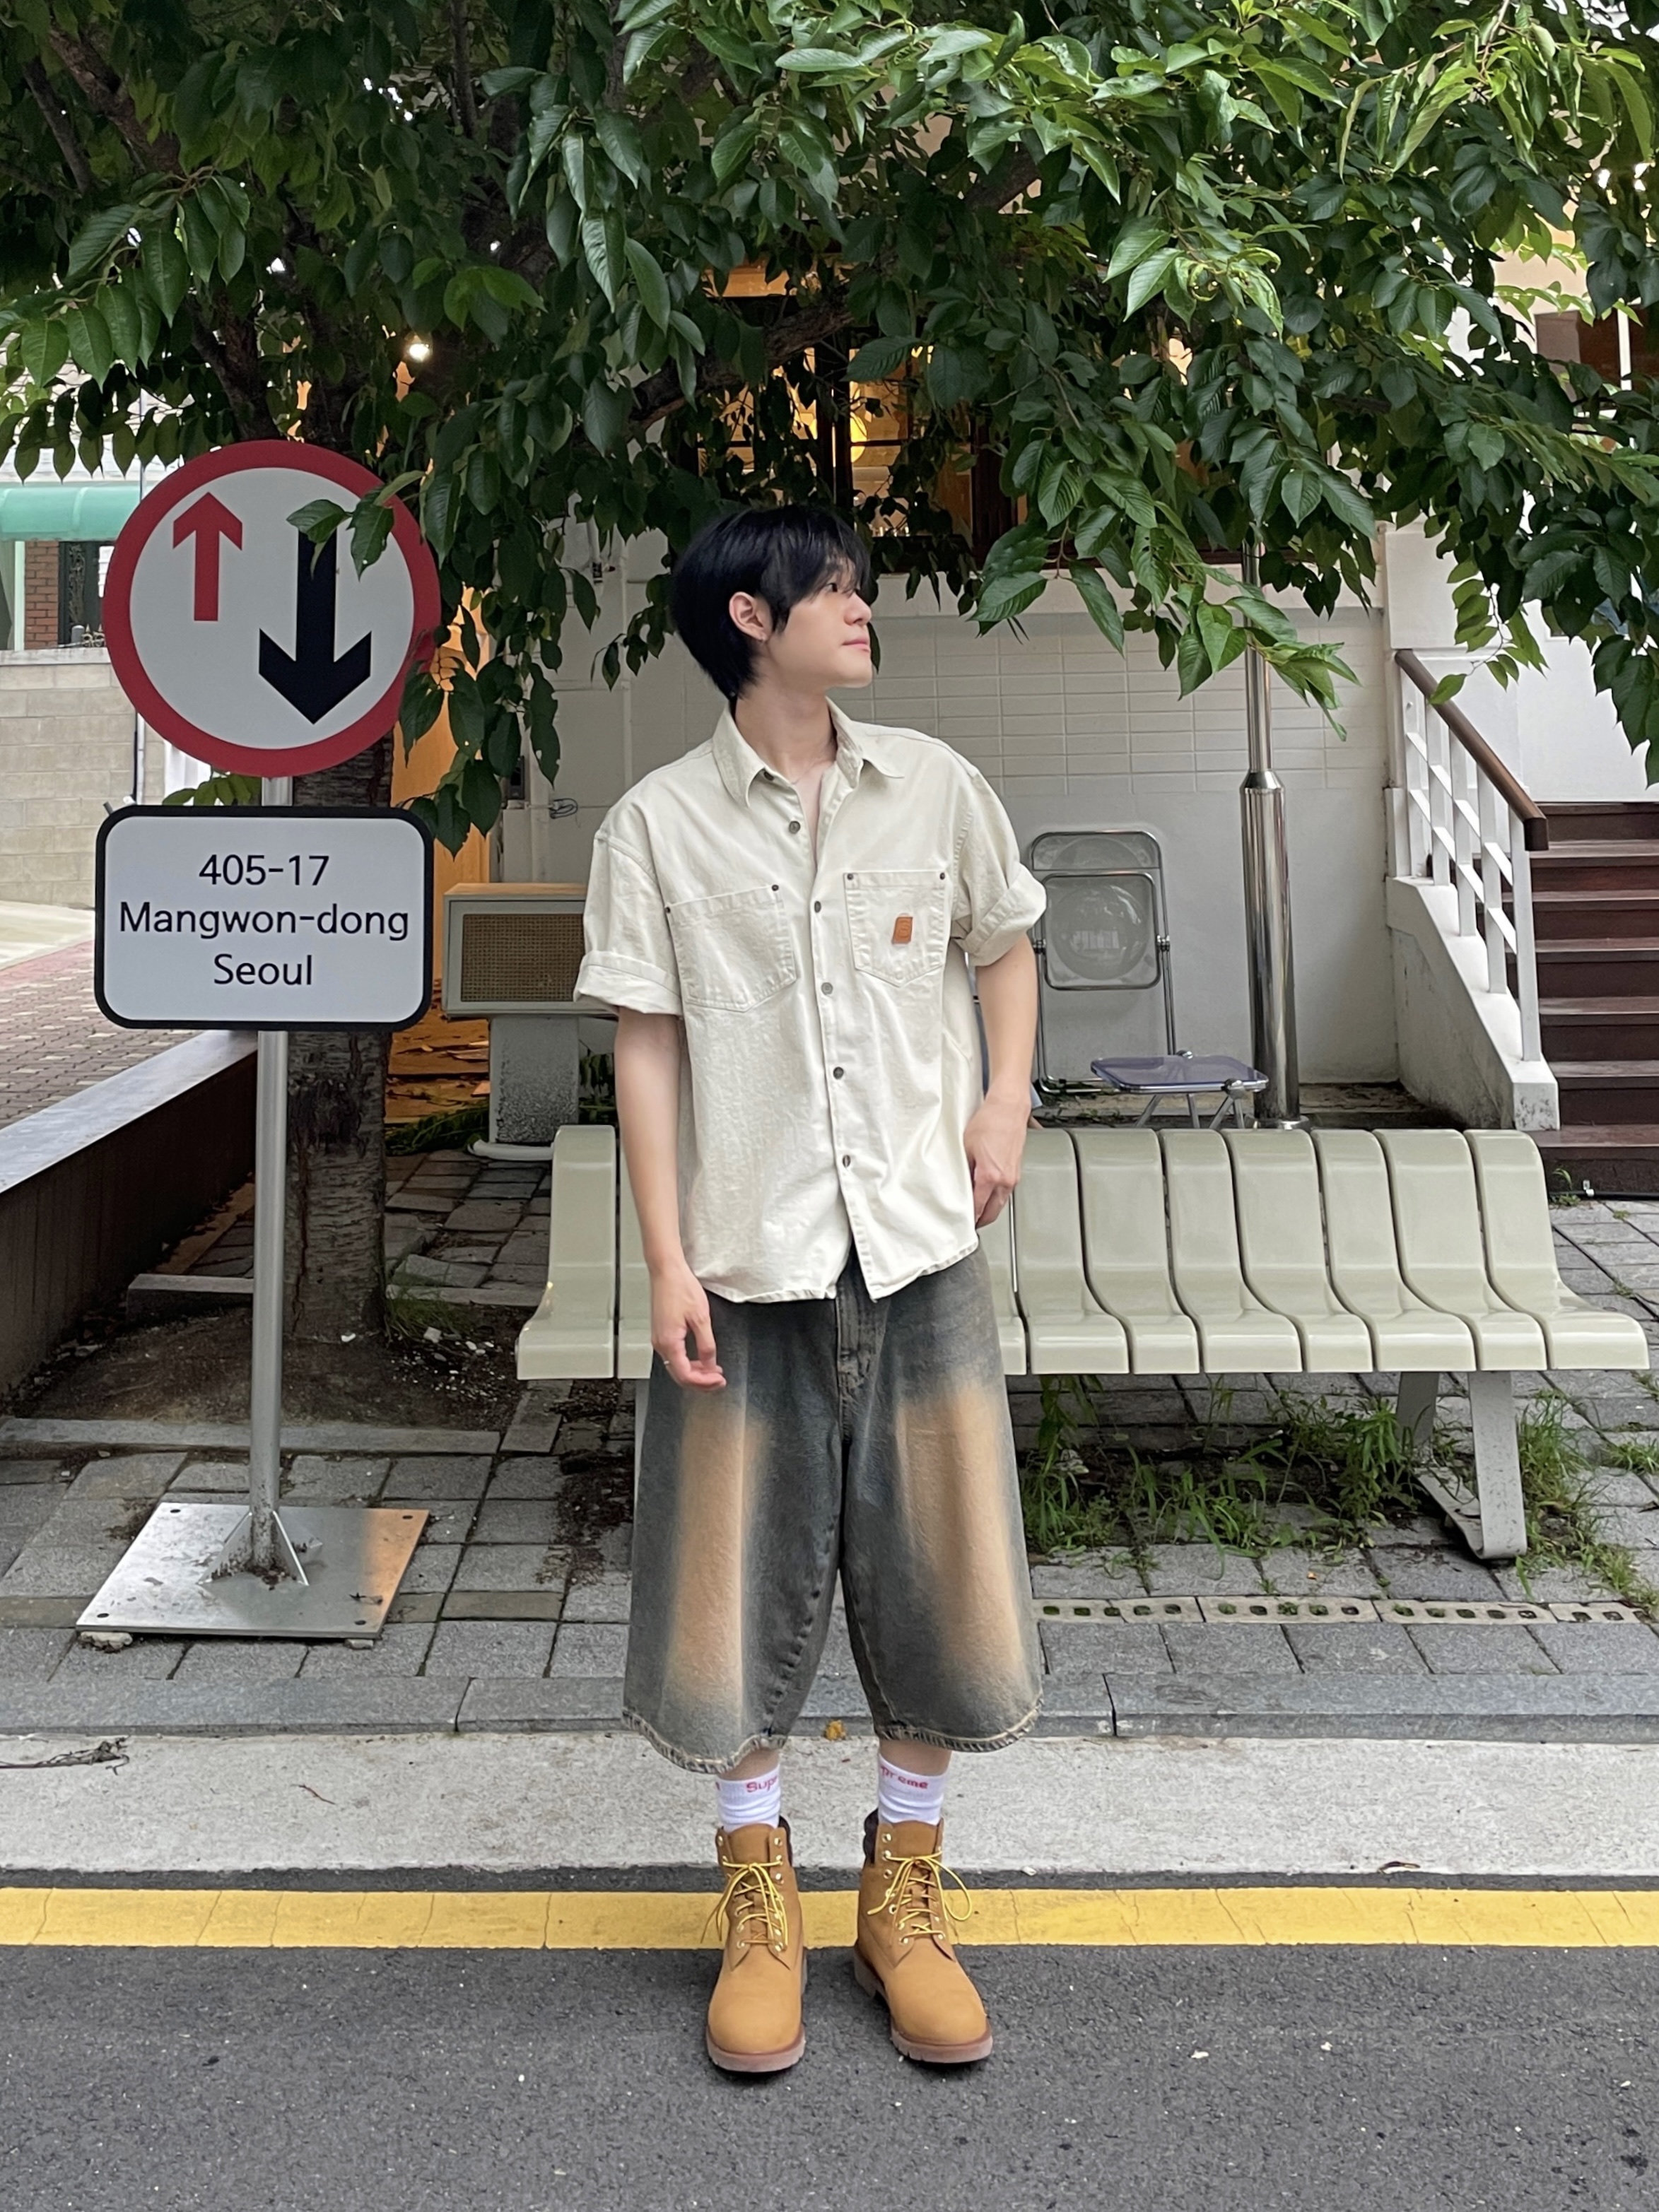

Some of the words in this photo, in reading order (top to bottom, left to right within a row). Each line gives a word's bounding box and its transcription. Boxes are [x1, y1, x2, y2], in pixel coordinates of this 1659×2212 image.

[199, 854, 330, 886] 405-17
[119, 901, 409, 941] Mangwon-dong
[213, 953, 312, 985] Seoul
